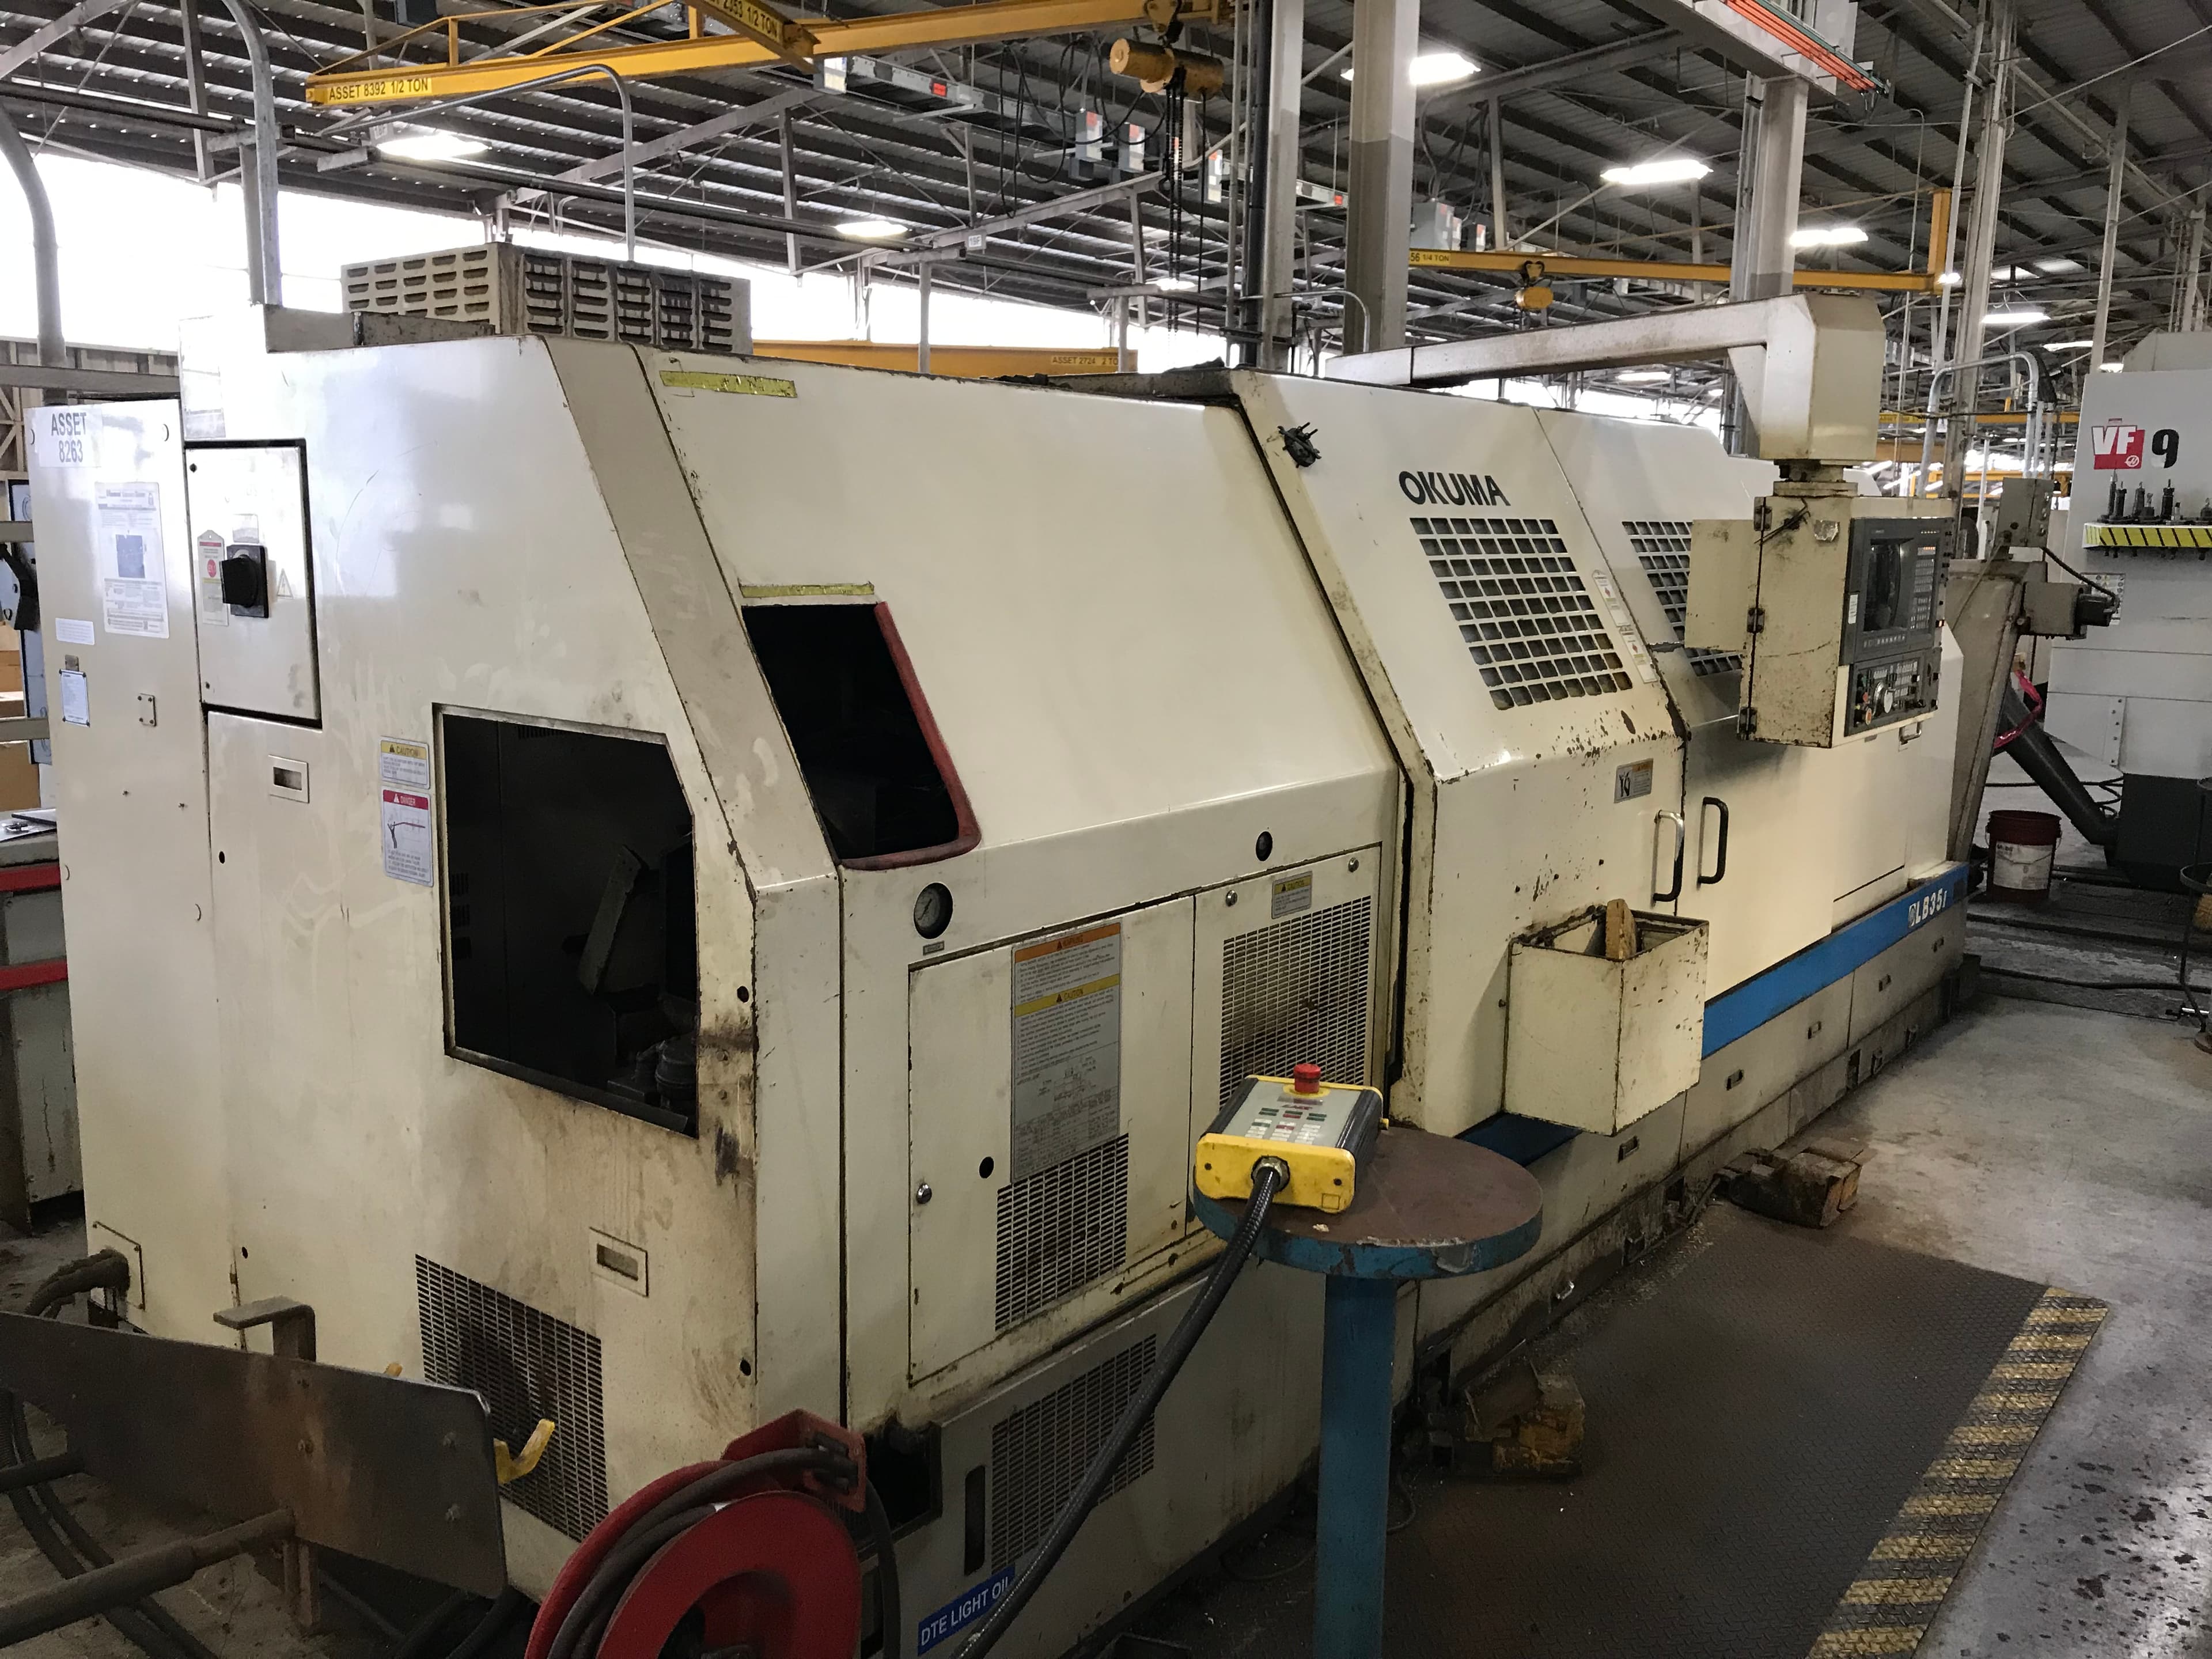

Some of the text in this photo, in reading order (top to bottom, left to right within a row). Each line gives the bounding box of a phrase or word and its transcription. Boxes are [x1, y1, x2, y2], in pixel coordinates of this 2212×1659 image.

[760, 13, 778, 38] TON
[329, 77, 429, 100] ASSET 8392 1/2 TON
[1410, 252, 1420, 262] 56
[1101, 358, 1107, 366] 2
[51, 412, 86, 436] ASSET
[59, 440, 84, 463] 8263
[2092, 425, 2179, 468] VF 9
[1399, 471, 1512, 506] OKUMA
[922, 1615, 947, 1646] DTE
[950, 1589, 988, 1628] LIGHT
